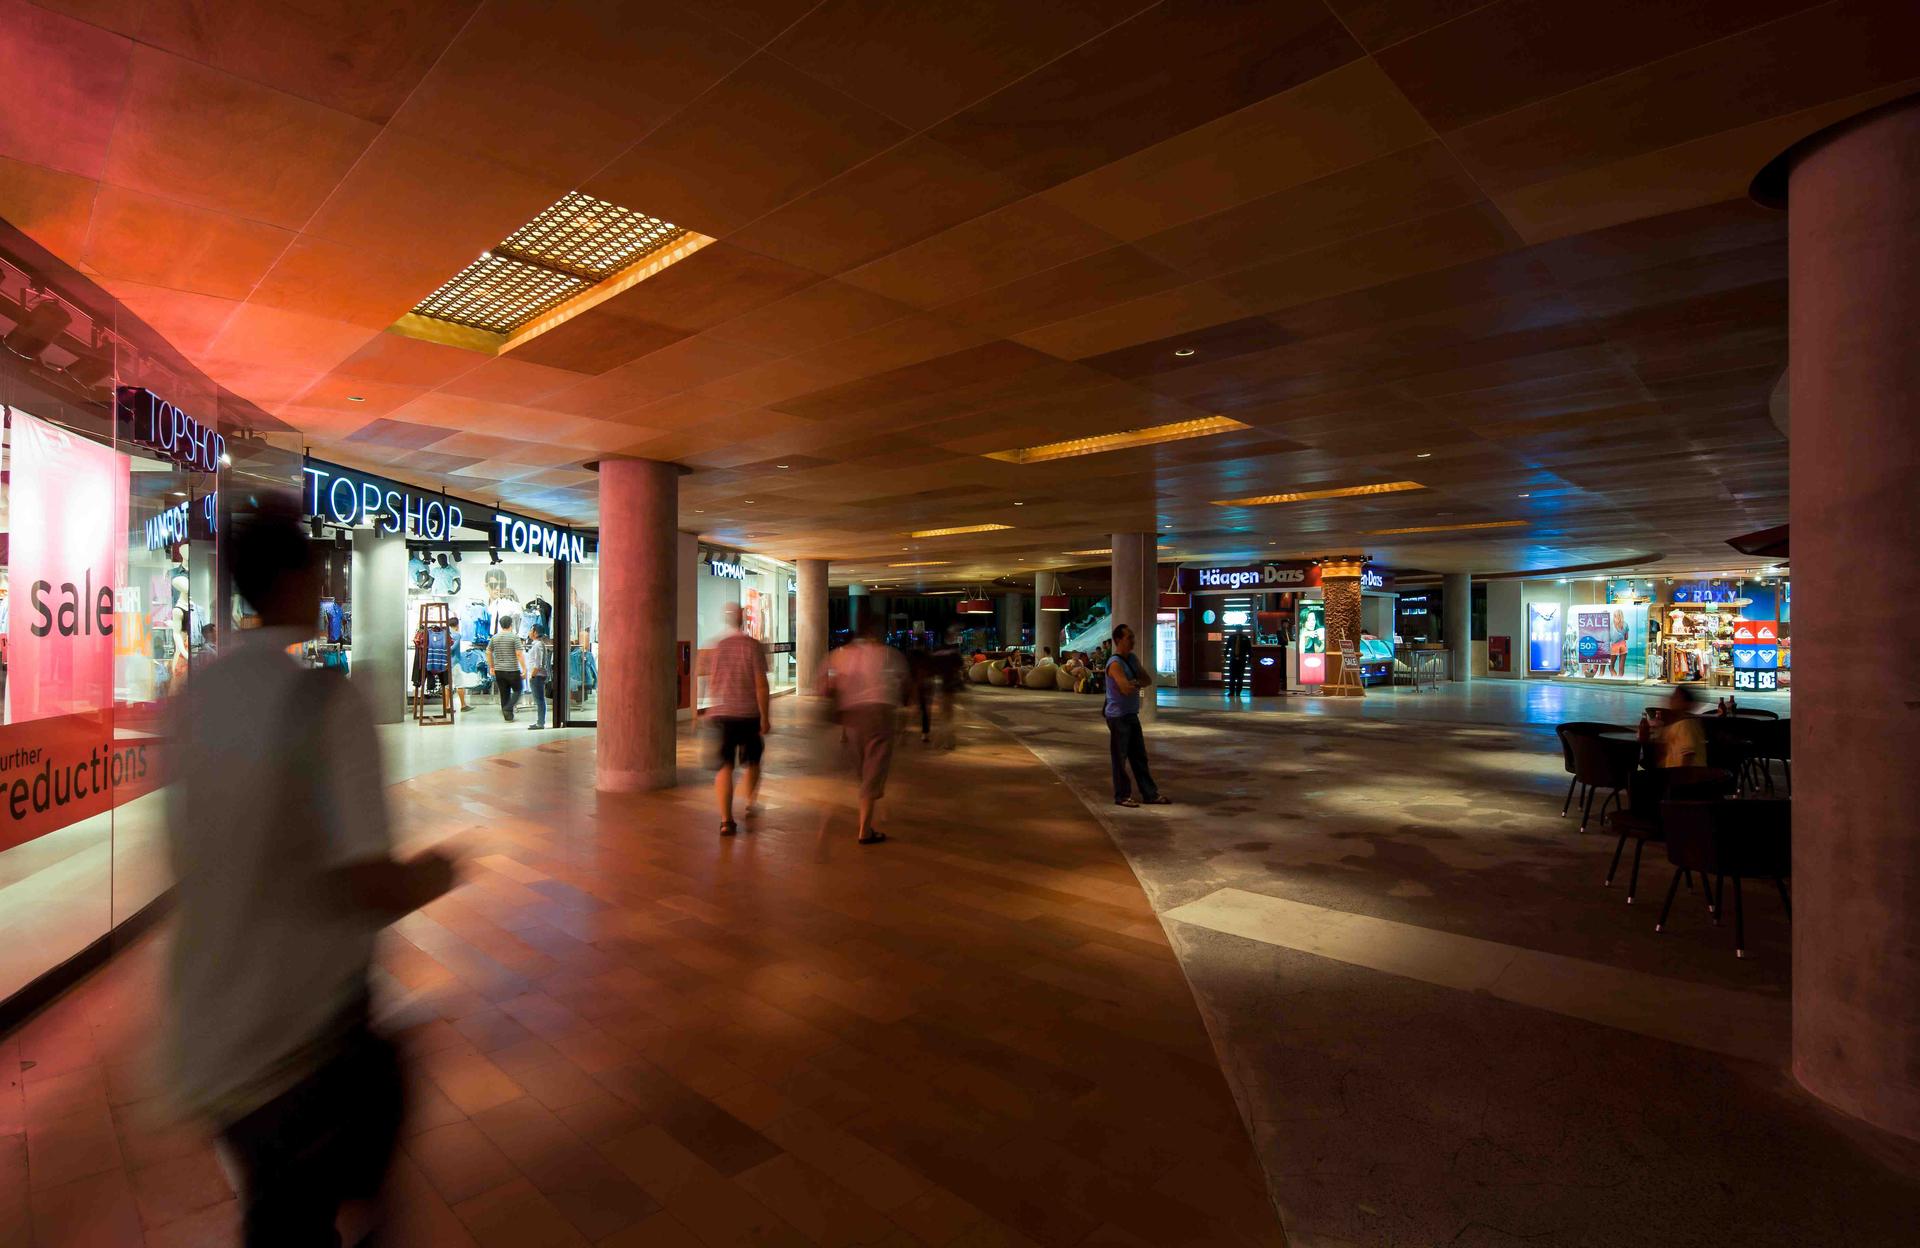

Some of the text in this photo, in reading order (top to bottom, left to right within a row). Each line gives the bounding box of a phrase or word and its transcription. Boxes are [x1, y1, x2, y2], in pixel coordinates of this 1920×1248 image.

[145, 388, 226, 473] TOPSHOP
[302, 466, 463, 541] TOPSHOP
[495, 514, 584, 564] TOPMAN
[712, 560, 746, 580] TOPMAN
[30, 567, 113, 637] sale
[1693, 590, 1737, 603] ROXY
[1579, 617, 1609, 628] SALE
[1735, 671, 1755, 689] DC
[1758, 671, 1776, 689] DC
[0, 746, 43, 772] urther
